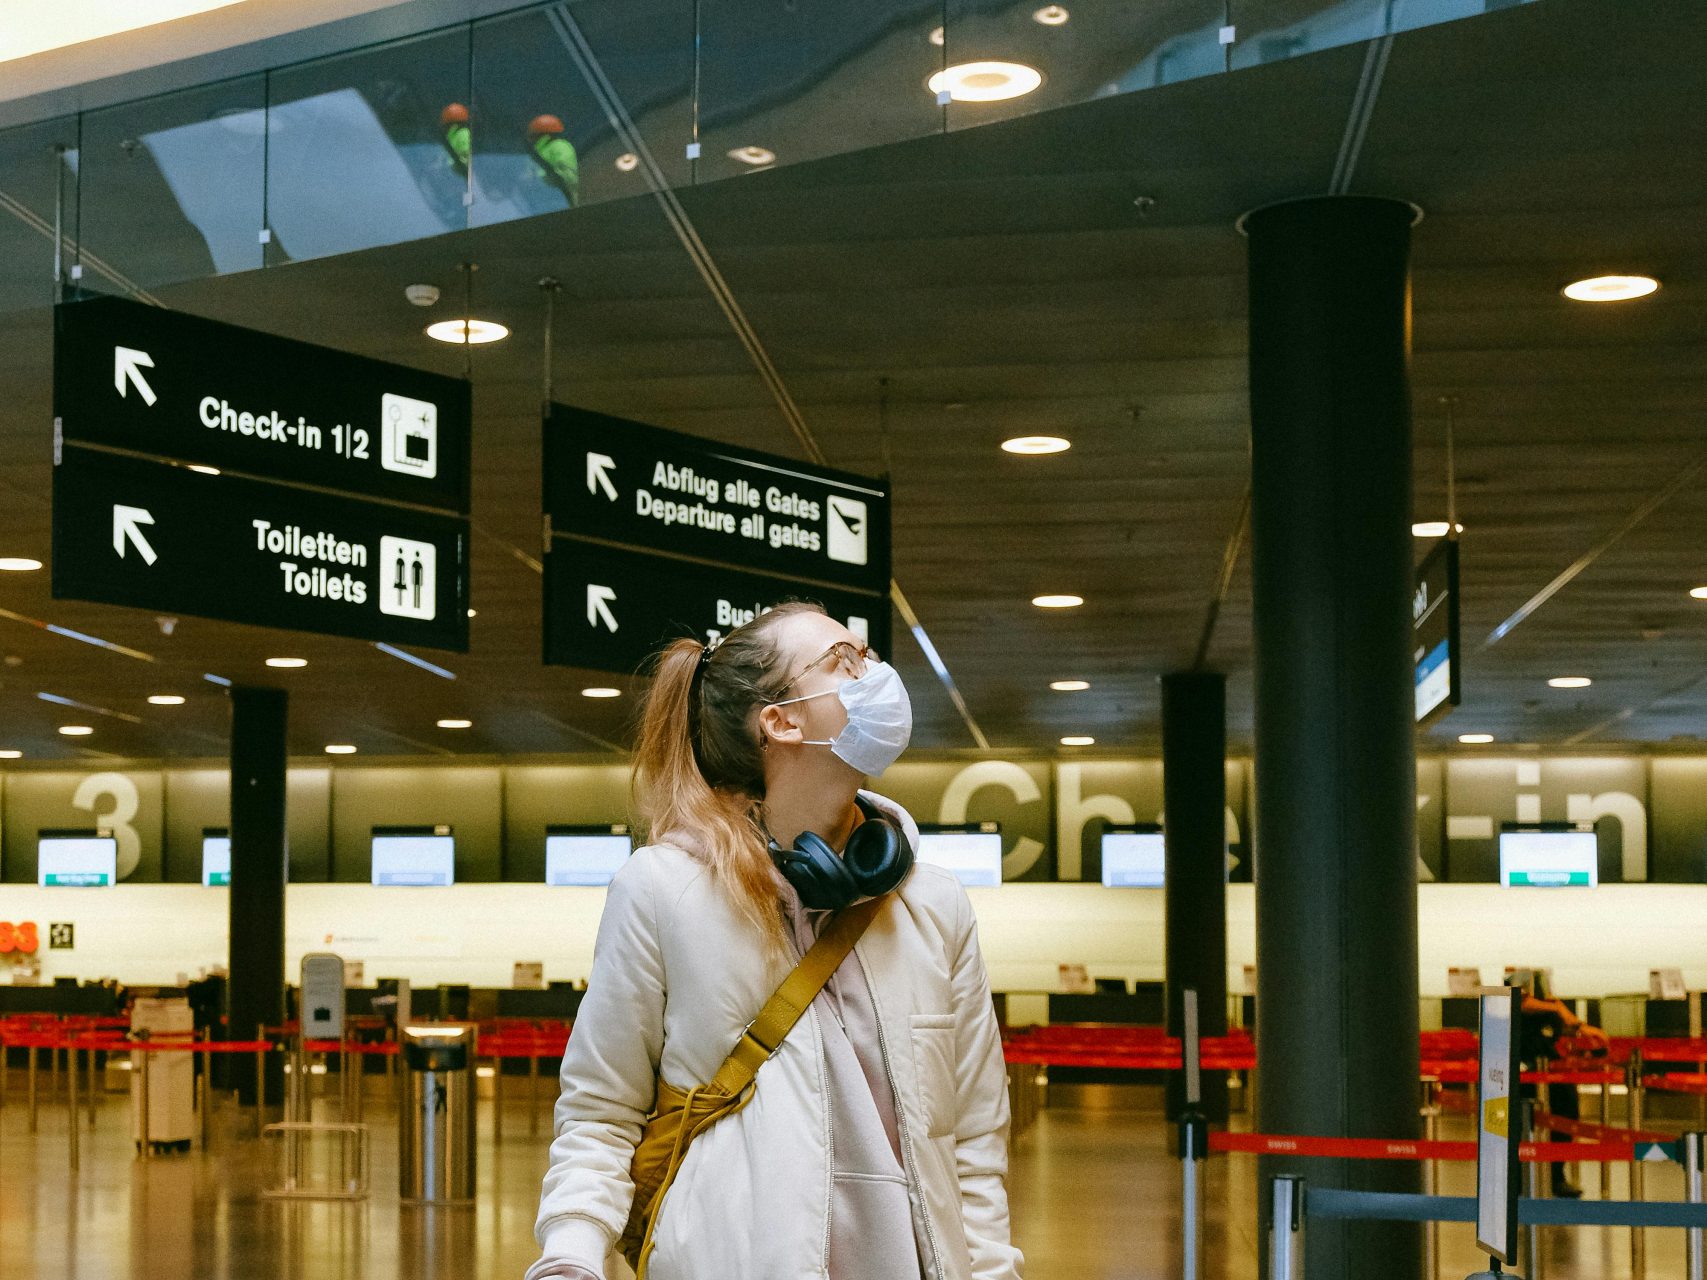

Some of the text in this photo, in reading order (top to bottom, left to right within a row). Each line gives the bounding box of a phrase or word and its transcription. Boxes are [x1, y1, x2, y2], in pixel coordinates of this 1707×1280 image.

[199, 396, 322, 449] Check-in
[652, 461, 820, 521] Abflug alle Gates
[252, 519, 367, 567] Toiletten
[637, 489, 821, 551] Departure all gates
[279, 562, 367, 604] Toilets
[74, 772, 141, 881] 3
